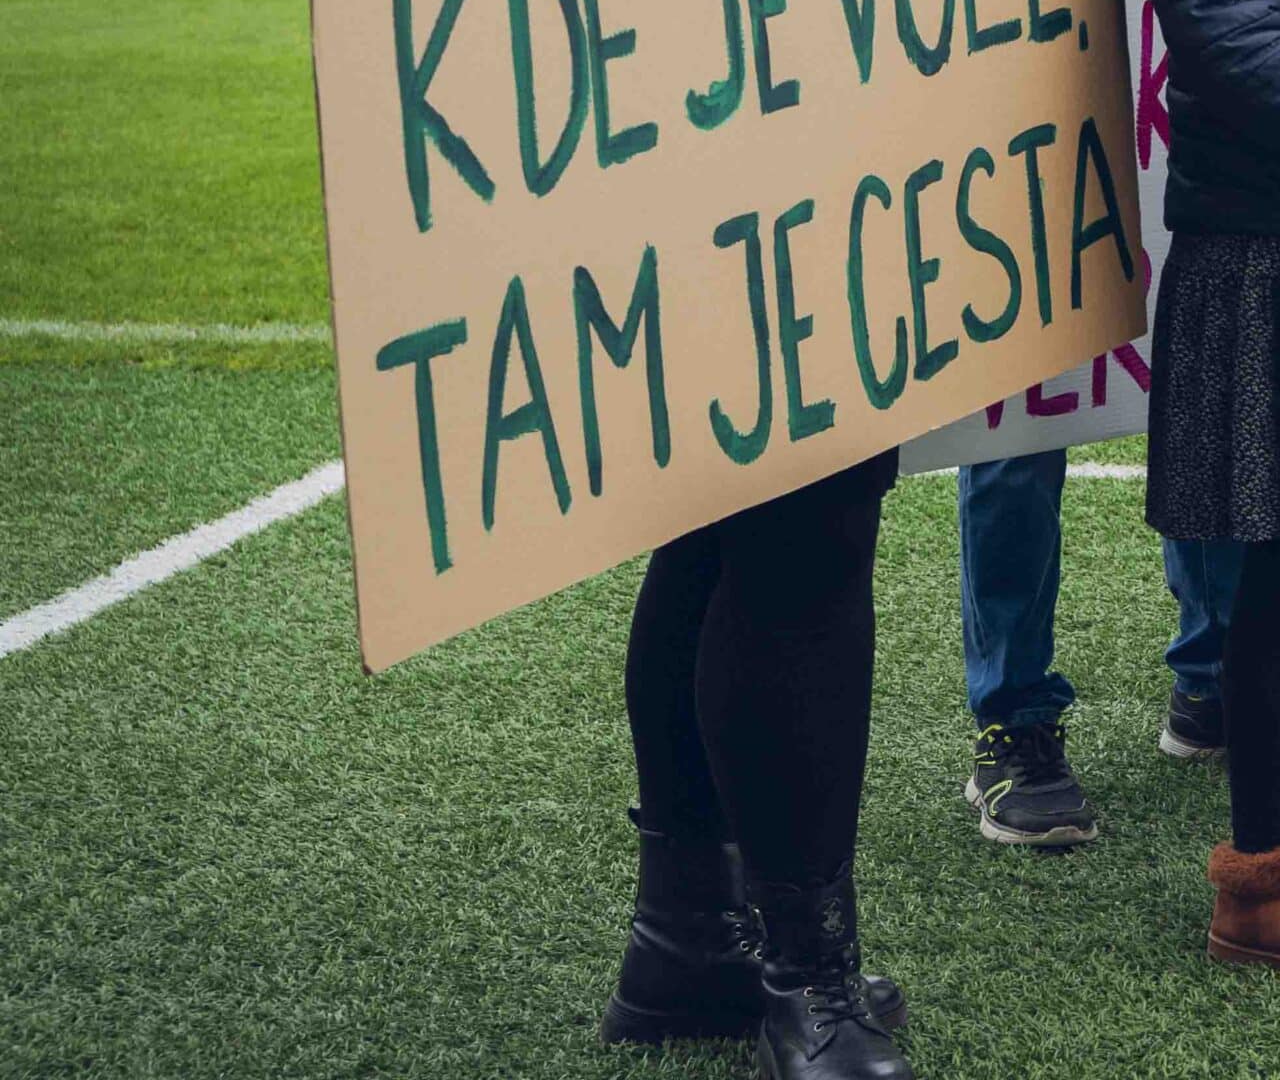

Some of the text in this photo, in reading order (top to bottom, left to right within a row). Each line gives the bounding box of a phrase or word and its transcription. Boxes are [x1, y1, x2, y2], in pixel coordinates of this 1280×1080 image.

[377, 117, 1136, 575] TAM JE CESTA
